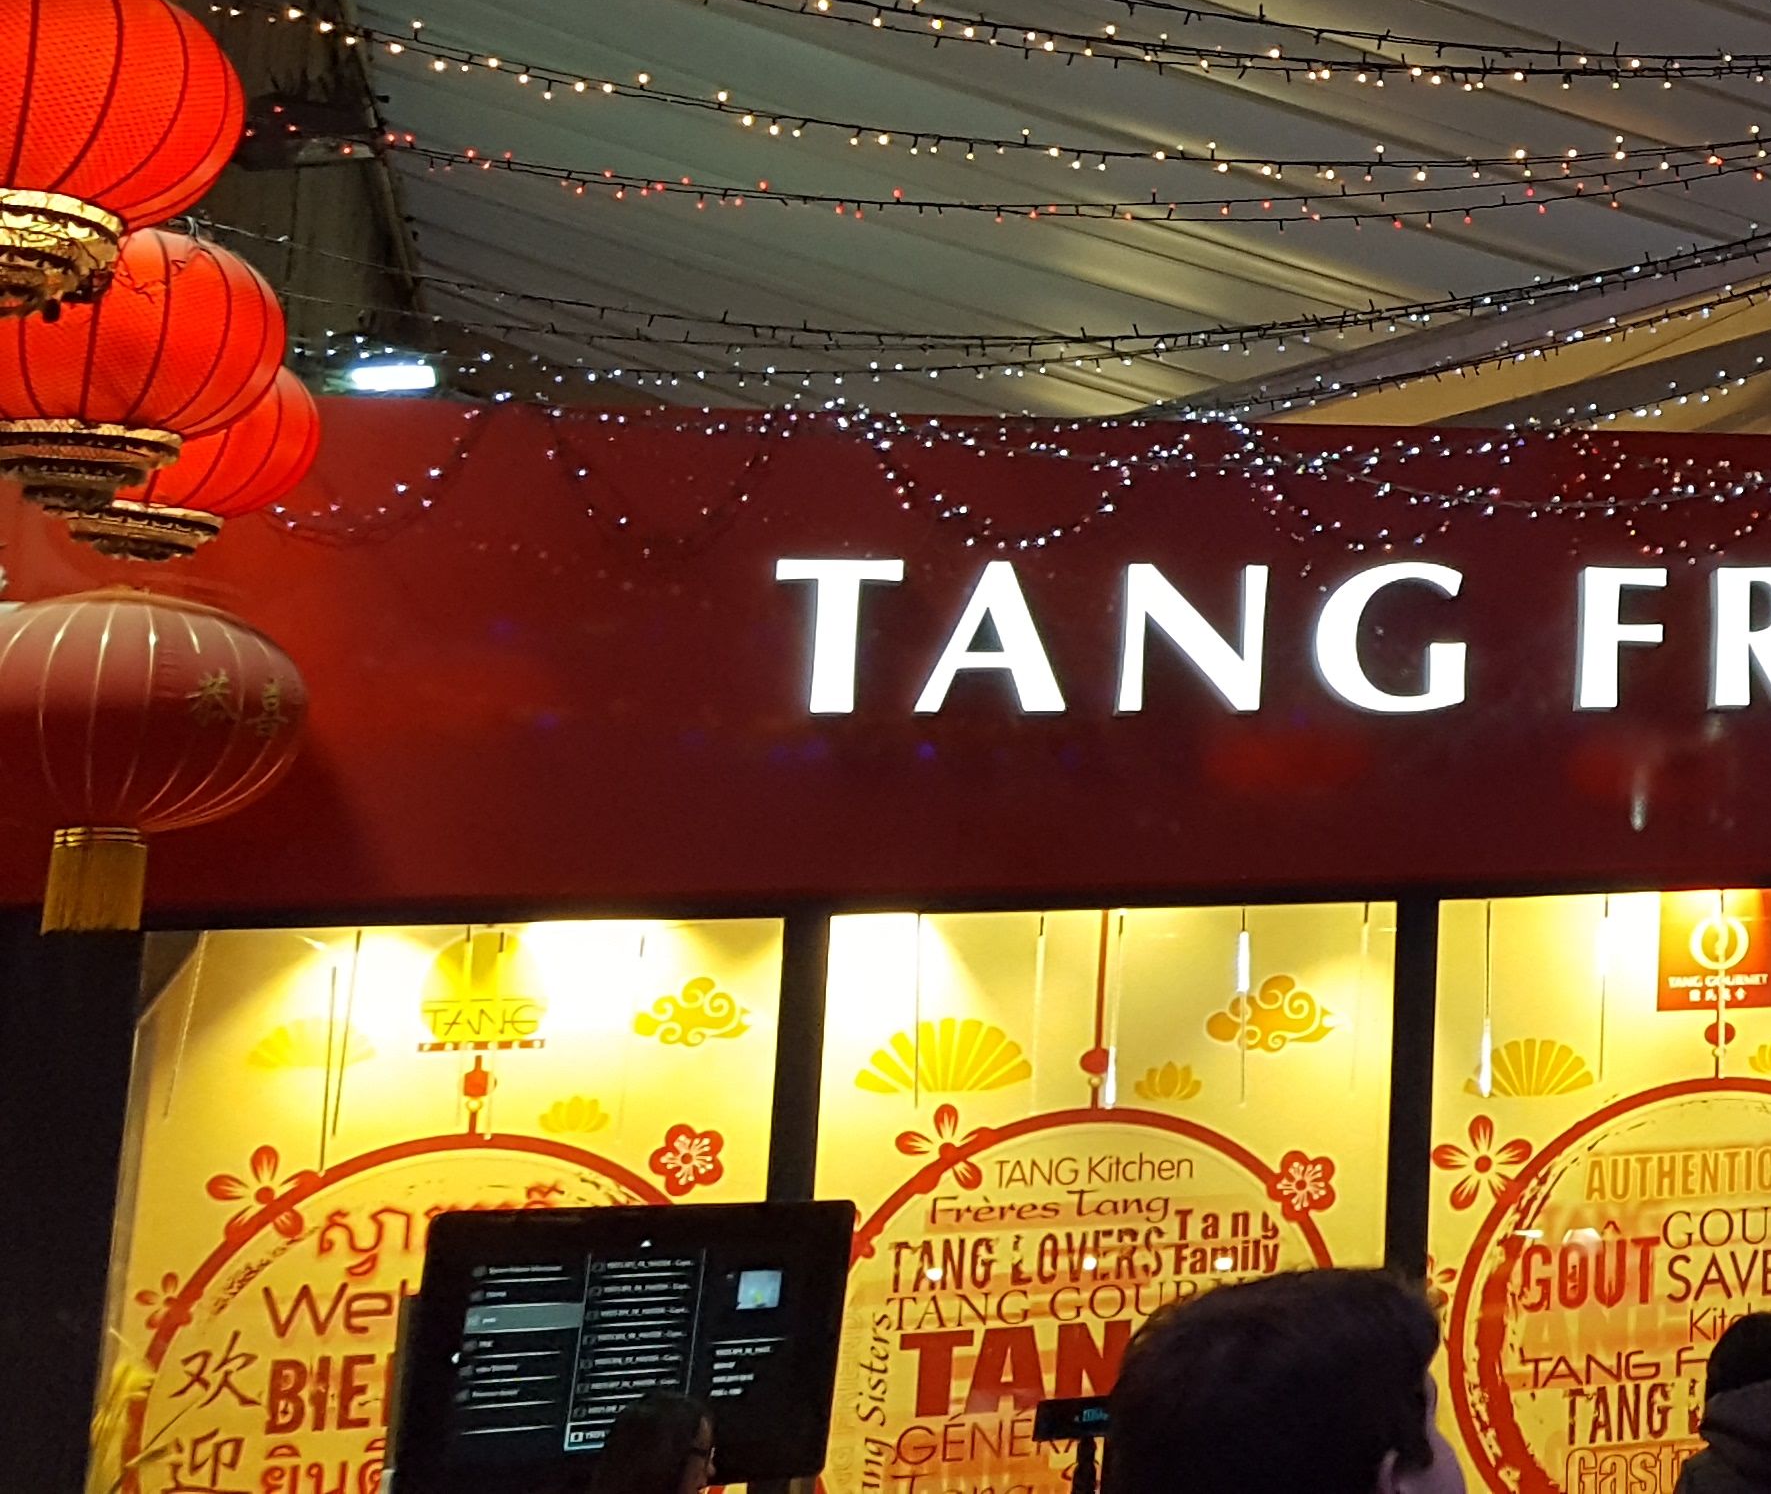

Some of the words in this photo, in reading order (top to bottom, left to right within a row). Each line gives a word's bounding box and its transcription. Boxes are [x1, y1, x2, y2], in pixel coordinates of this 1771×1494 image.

[775, 559, 1467, 713] TANG
[994, 1157, 1080, 1190] TANG
[1087, 1152, 1194, 1186] Kitchen
[929, 1194, 1060, 1225] Frères
[1066, 1189, 1170, 1223] Tang
[1174, 1208, 1280, 1241] Tang
[888, 1237, 999, 1293] TANG
[1009, 1225, 1167, 1286] LOVERS
[1173, 1238, 1280, 1276] Family
[1520, 1220, 1661, 1314] GOÛT
[885, 1289, 1031, 1332] TANG
[856, 1312, 892, 1428] Sisters
[1519, 1346, 1662, 1389] TANG
[1563, 1382, 1676, 1446] TANG
